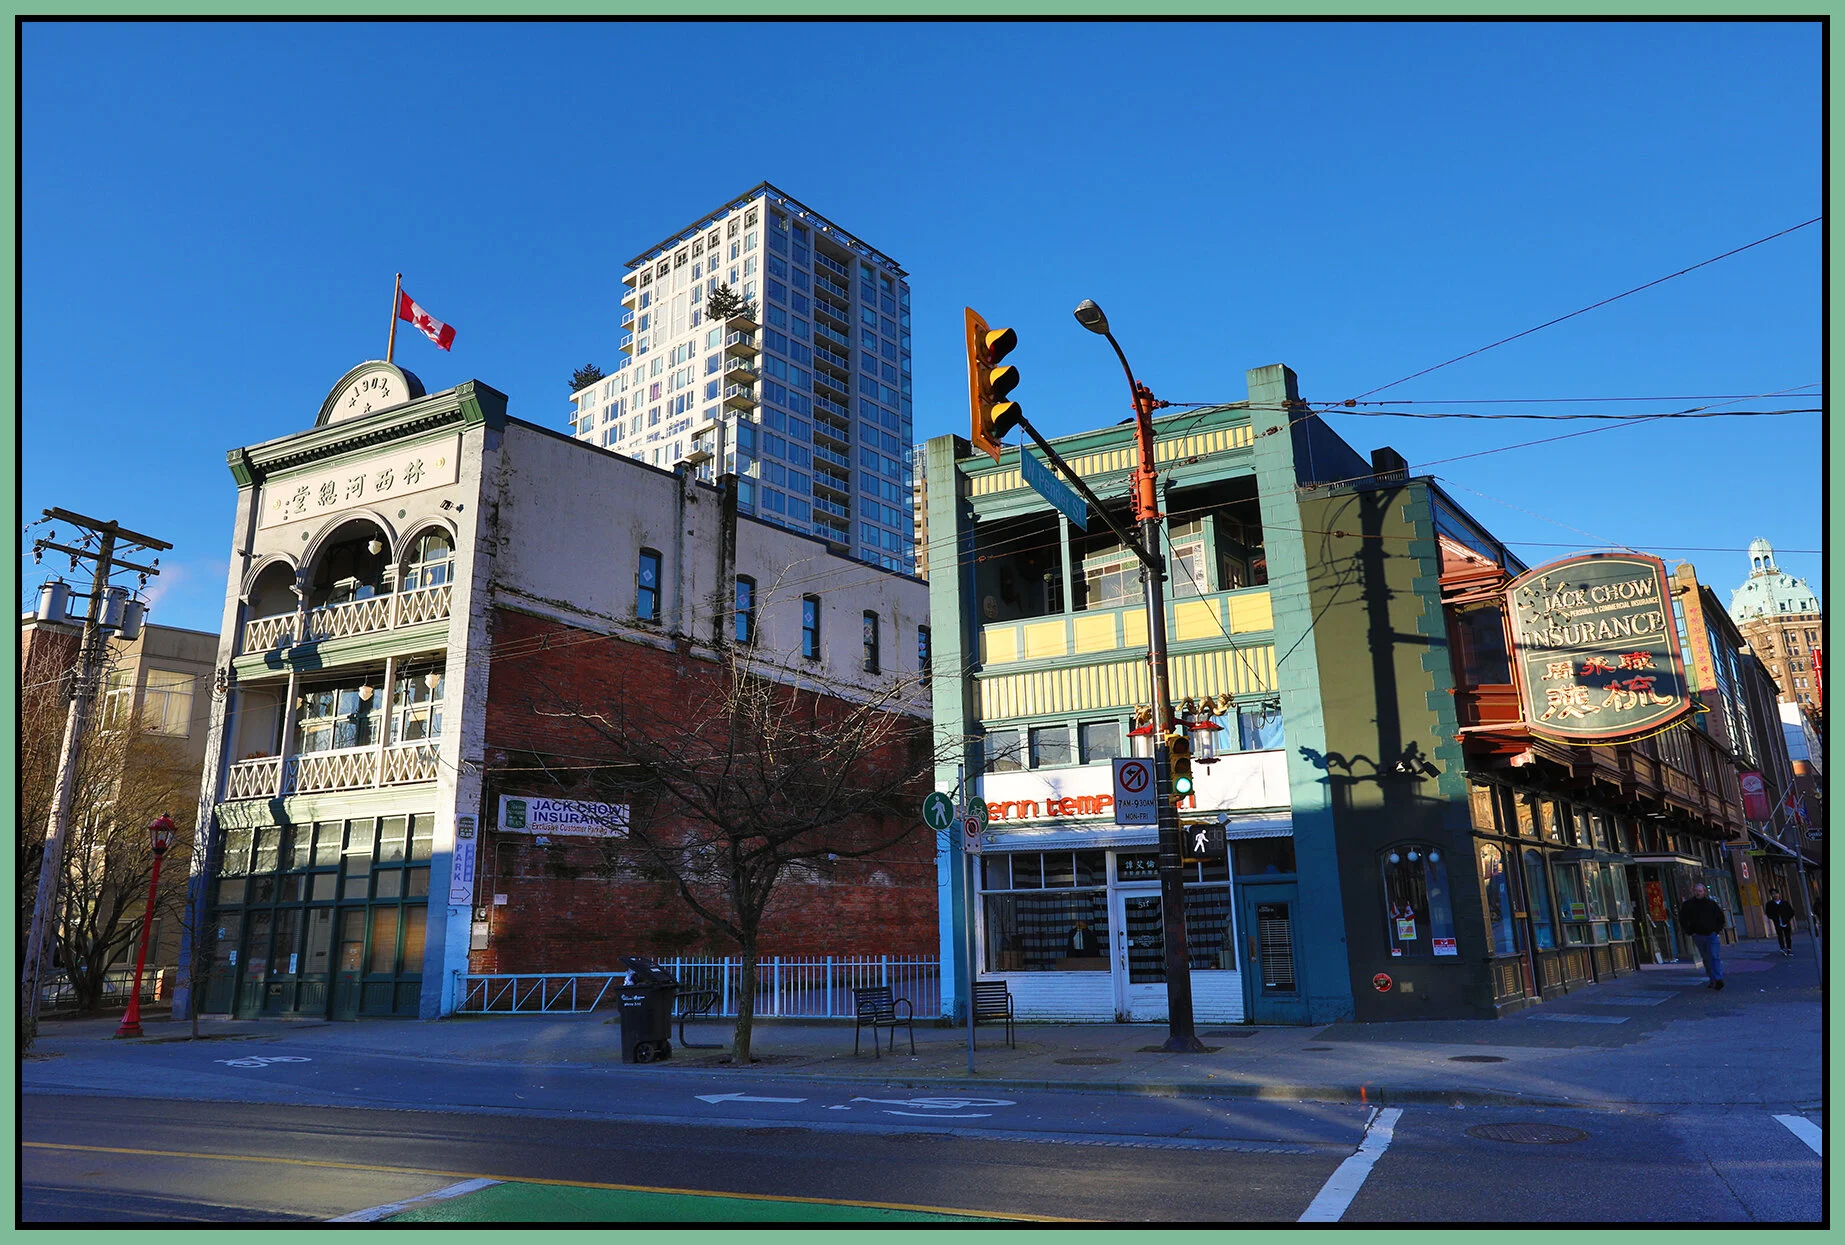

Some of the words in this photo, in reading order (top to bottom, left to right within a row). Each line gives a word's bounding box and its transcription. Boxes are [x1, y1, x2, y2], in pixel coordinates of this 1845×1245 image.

[1025, 455, 1035, 481] W
[1039, 468, 1069, 512] Pender
[1073, 499, 1084, 523] St
[1542, 590, 1590, 612] JACK
[1591, 578, 1654, 603] CHOW
[1570, 607, 1594, 617] PERSONAL
[1598, 601, 1631, 613] COMMERCIAL
[1630, 596, 1659, 606] INSURANCE
[1522, 610, 1666, 651] INSURANCE
[1540, 675, 1674, 720] 燕梳
[532, 800, 572, 812] JACK
[577, 802, 621, 816] CHOW
[533, 811, 620, 826] INSURANCE
[1125, 812, 1149, 821] MON-FRI
[531, 822, 558, 831] Exclusive
[559, 823, 586, 833] Customer
[453, 844, 463, 881] PARK
